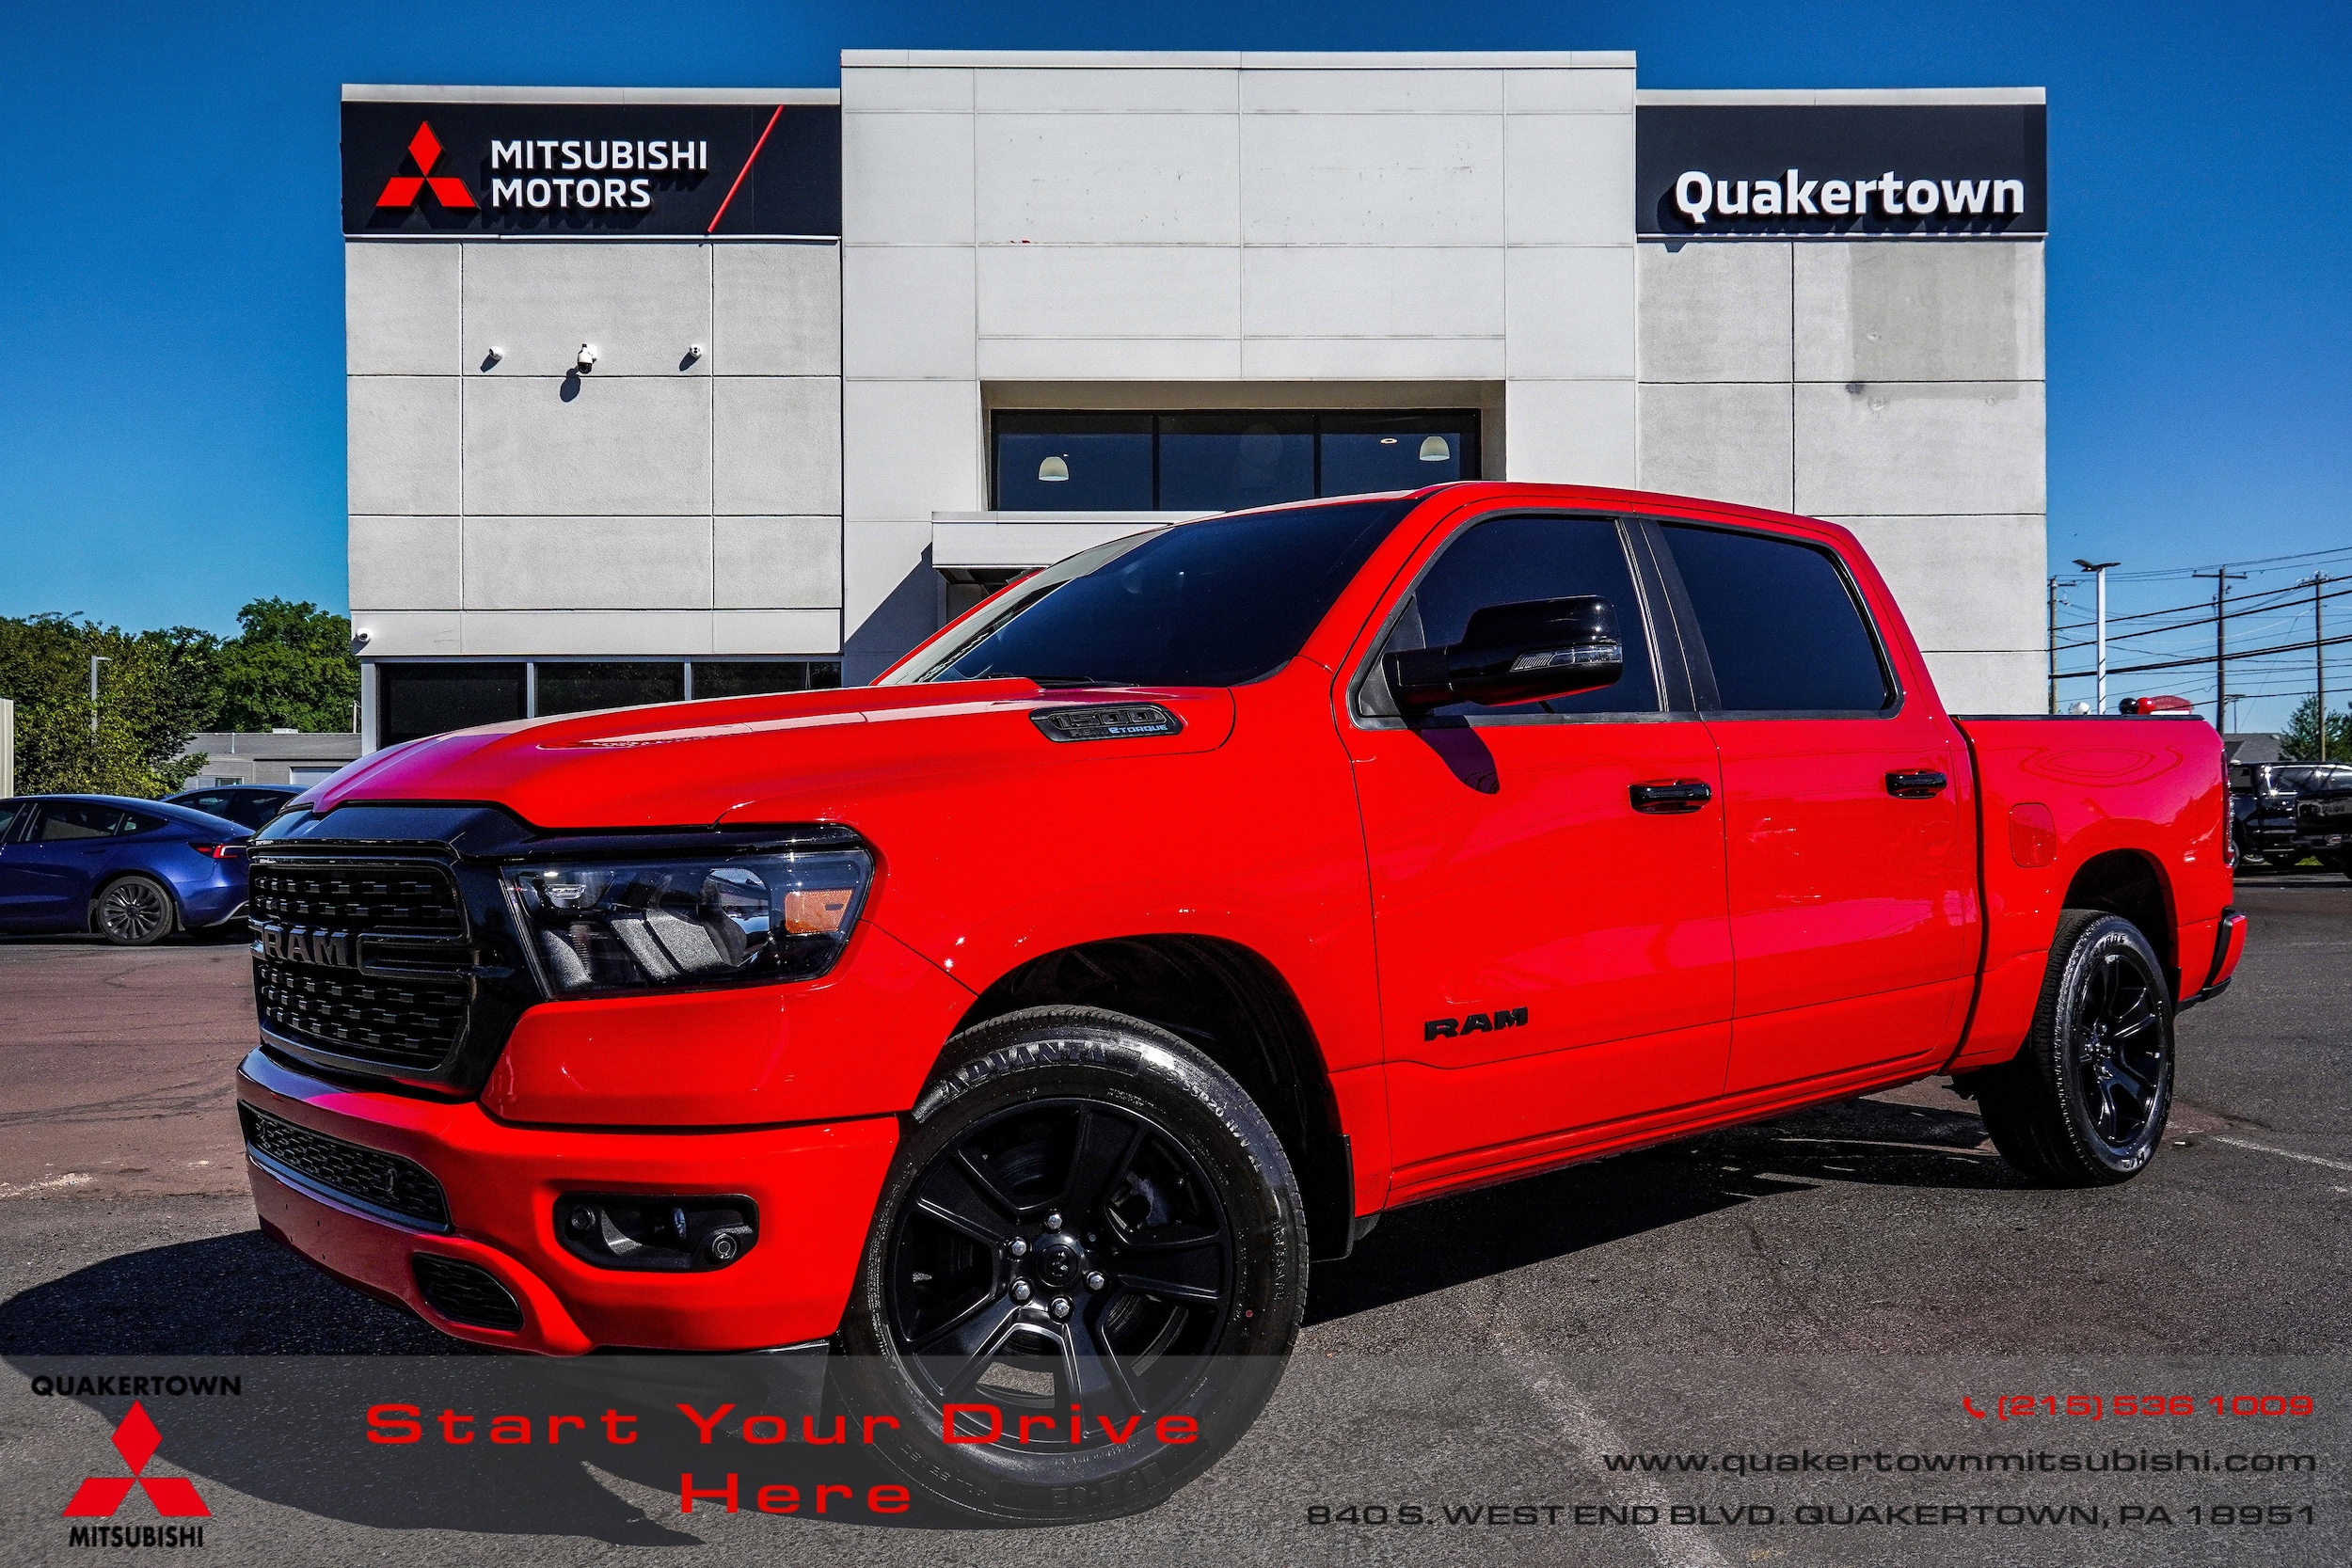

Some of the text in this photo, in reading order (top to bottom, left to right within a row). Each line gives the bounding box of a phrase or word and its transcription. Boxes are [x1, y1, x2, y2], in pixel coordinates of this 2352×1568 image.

[491, 140, 708, 170] MITSUBISHI
[492, 179, 652, 208] MOTORS
[1676, 168, 2026, 223] Quakertown
[1052, 708, 1158, 730] 1500
[263, 924, 348, 966] RAM
[1424, 1006, 1529, 1042] RAM
